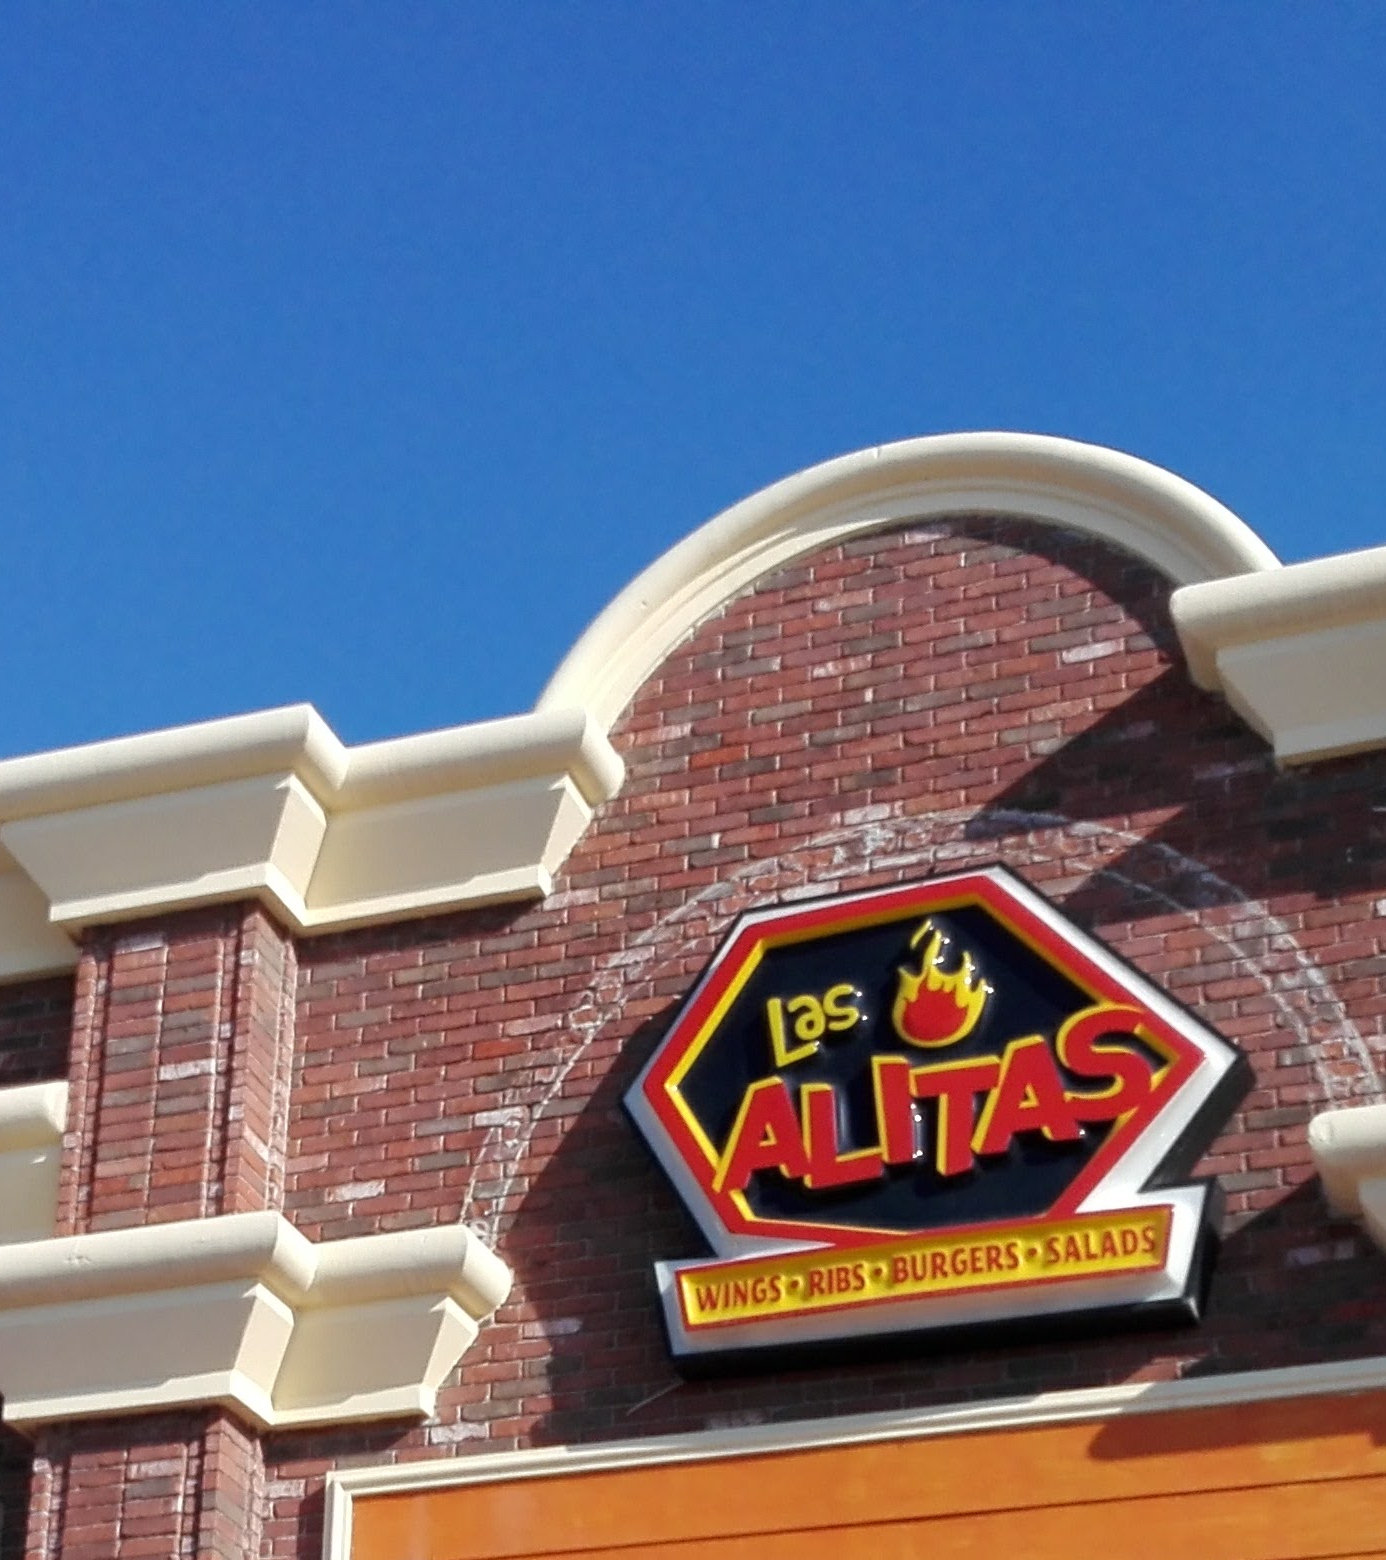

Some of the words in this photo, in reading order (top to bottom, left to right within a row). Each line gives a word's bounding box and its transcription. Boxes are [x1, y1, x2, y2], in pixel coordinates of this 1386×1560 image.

[713, 1002, 1153, 1192] ALITAS
[694, 1278, 783, 1312] WINGS
[808, 1264, 867, 1298] RIBS
[892, 1242, 1021, 1284] BURGERS
[1046, 1225, 1156, 1266] SALADS
